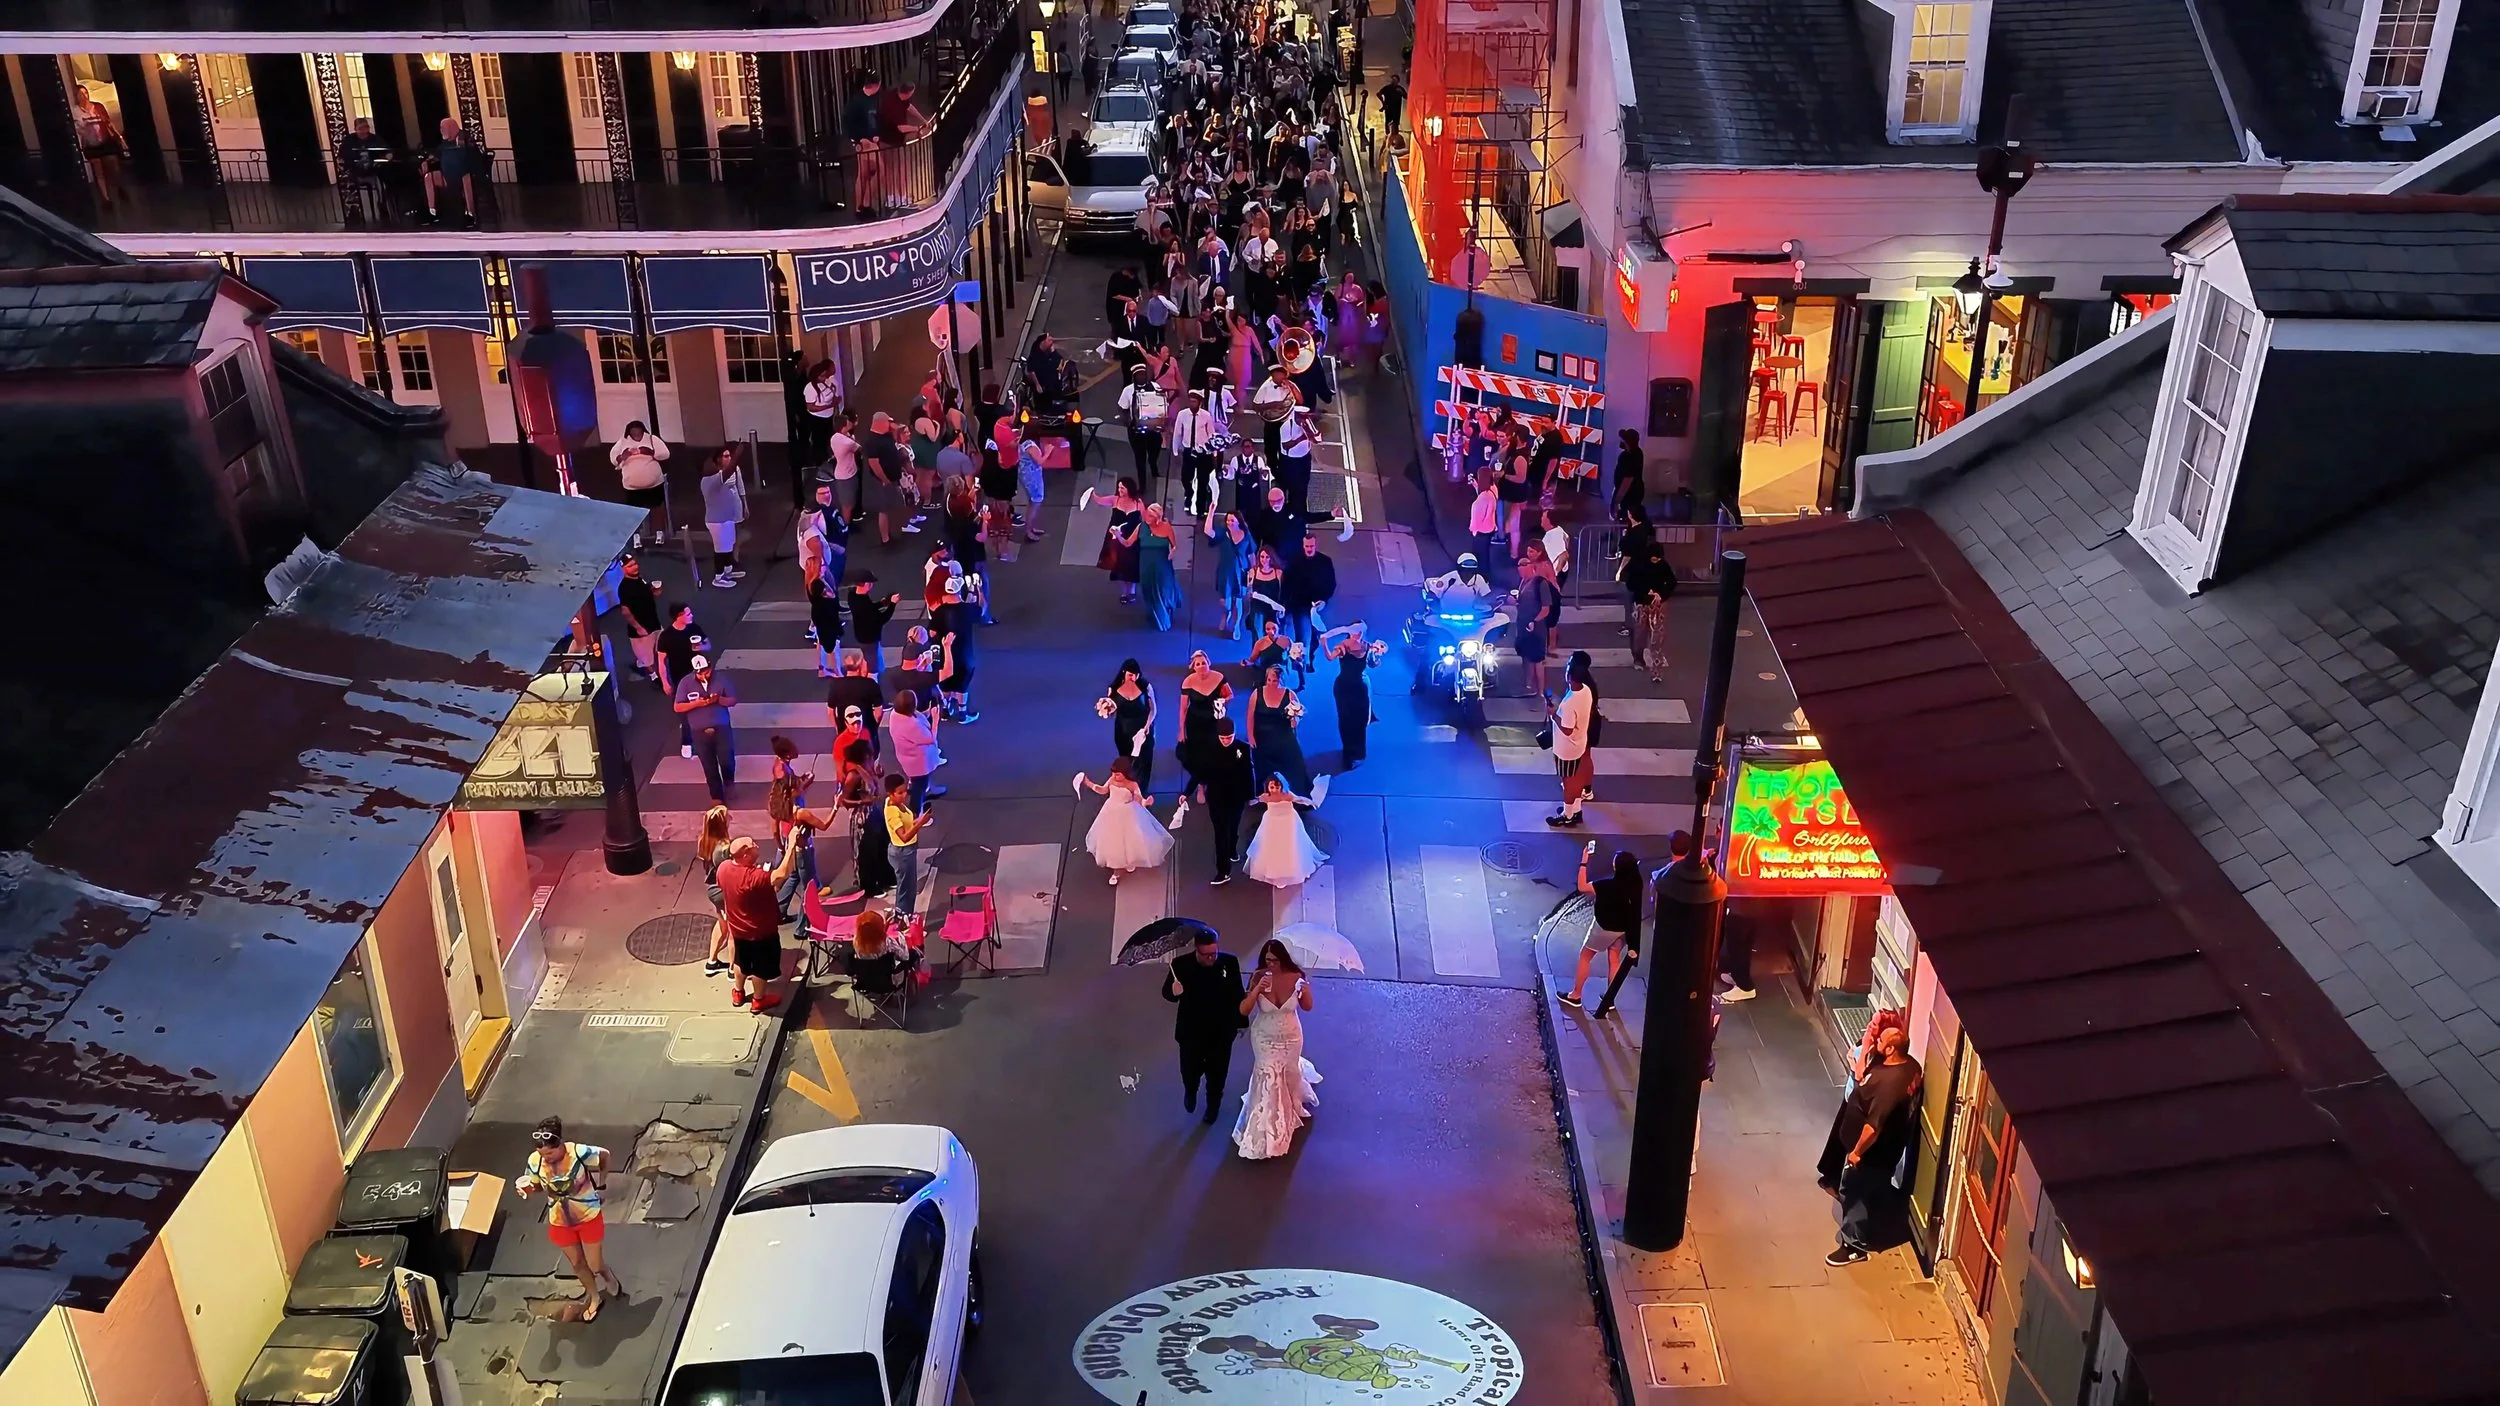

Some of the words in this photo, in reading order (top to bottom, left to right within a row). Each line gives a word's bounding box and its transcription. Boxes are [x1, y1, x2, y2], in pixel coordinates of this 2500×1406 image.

[810, 254, 889, 286] FOUR
[912, 276, 925, 289] BY
[1163, 1273, 1260, 1301] New
[1190, 1286, 1321, 1320] French
[1082, 1302, 1170, 1380] Orleans
[1437, 1318, 1472, 1343] Home
[1157, 1321, 1212, 1394] Quarter
[1474, 1357, 1486, 1373] The
[1455, 1375, 1484, 1398] Hand
